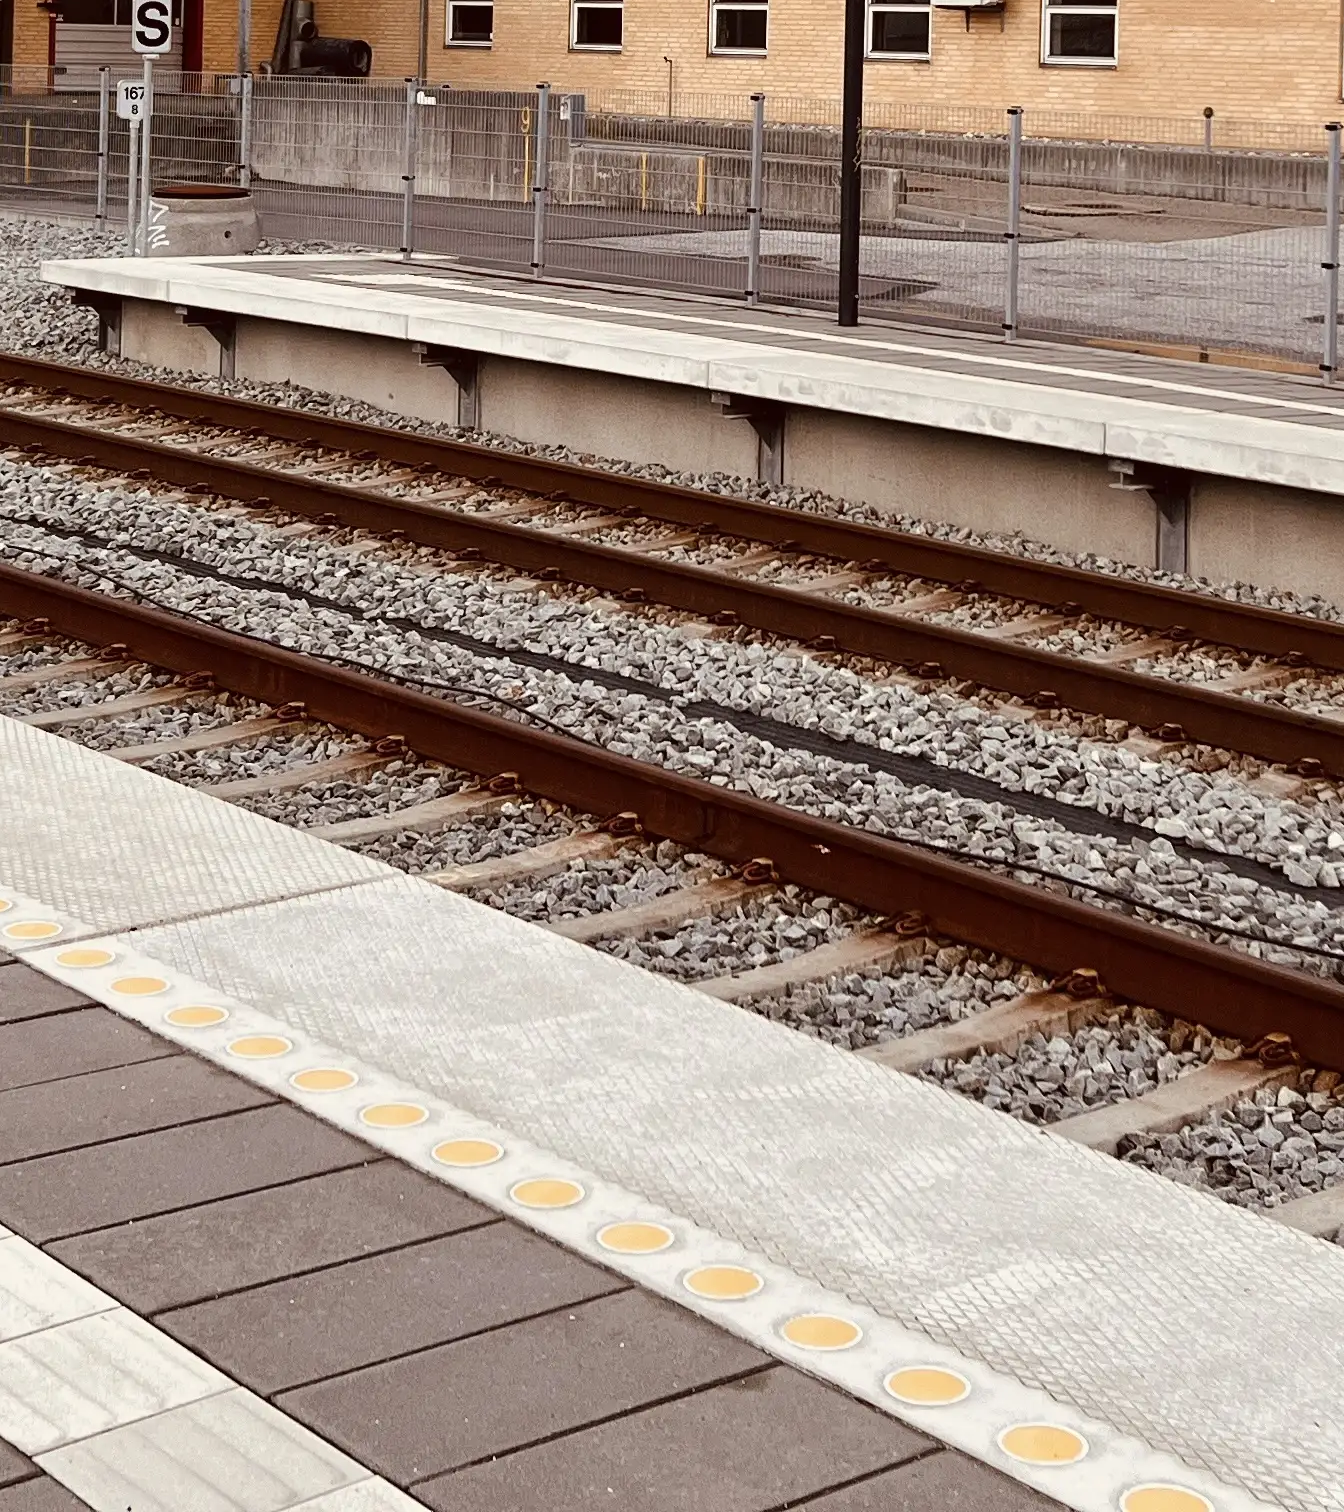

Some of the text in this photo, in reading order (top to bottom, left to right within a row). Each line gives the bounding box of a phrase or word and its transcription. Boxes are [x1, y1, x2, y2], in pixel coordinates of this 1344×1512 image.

[135, 0, 170, 48] S
[124, 86, 145, 100] 167
[131, 104, 138, 115] 8
